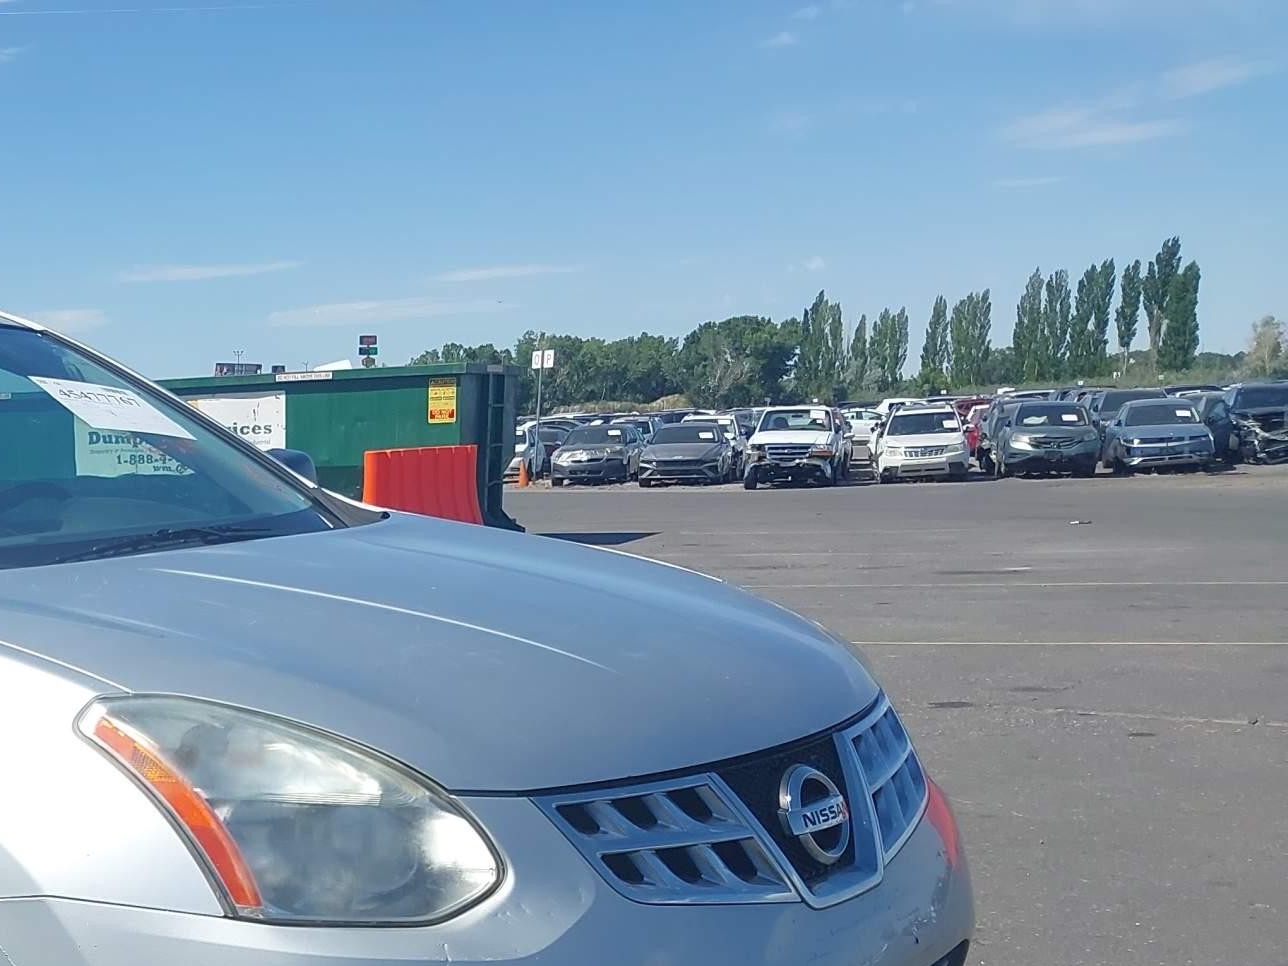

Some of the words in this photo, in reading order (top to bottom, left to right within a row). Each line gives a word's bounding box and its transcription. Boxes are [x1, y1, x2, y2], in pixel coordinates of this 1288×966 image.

[58, 388, 140, 407] 45477767
[88, 431, 143, 448] Dump
[228, 422, 272, 436] ices
